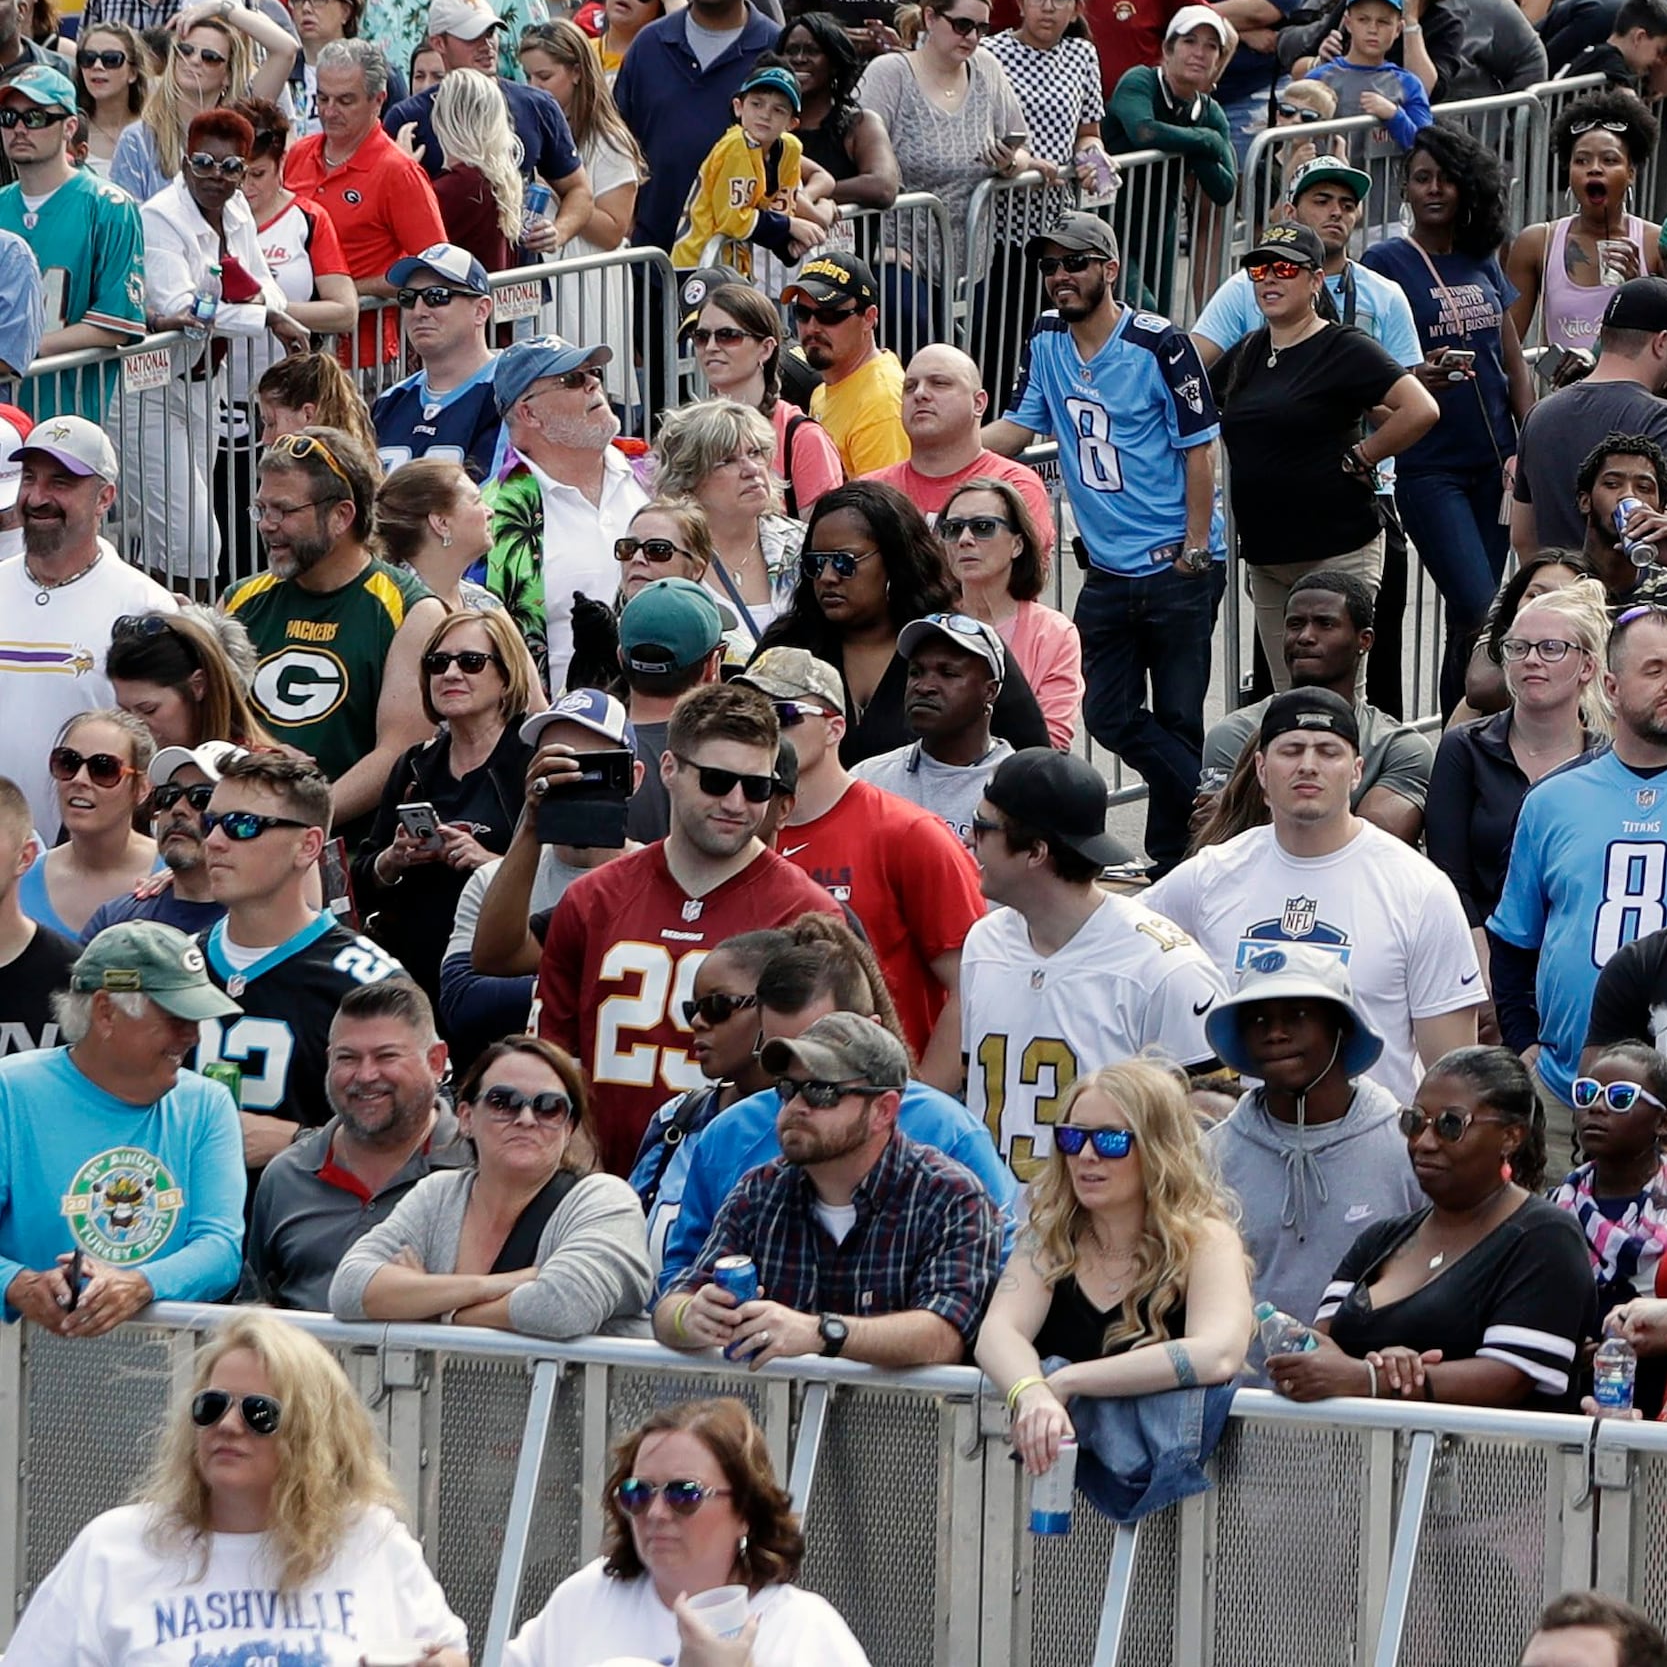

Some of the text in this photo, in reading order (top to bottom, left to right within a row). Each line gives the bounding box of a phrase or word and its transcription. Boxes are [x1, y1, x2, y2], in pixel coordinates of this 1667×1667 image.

[494, 281, 540, 308] NATIONAL
[125, 350, 169, 377] NATIONAL
[1064, 397, 1125, 493] 8
[284, 620, 336, 643] PACKERS
[259, 651, 341, 722] G
[1623, 820, 1661, 833] TITANS
[1283, 909, 1314, 932] NFL
[1593, 837, 1667, 970] 8
[975, 1031, 1078, 1182] 13
[109, 1149, 160, 1175] ANNUAL
[77, 1206, 172, 1259] TURKEY TROT
[153, 1589, 356, 1644] NASHVILLE
